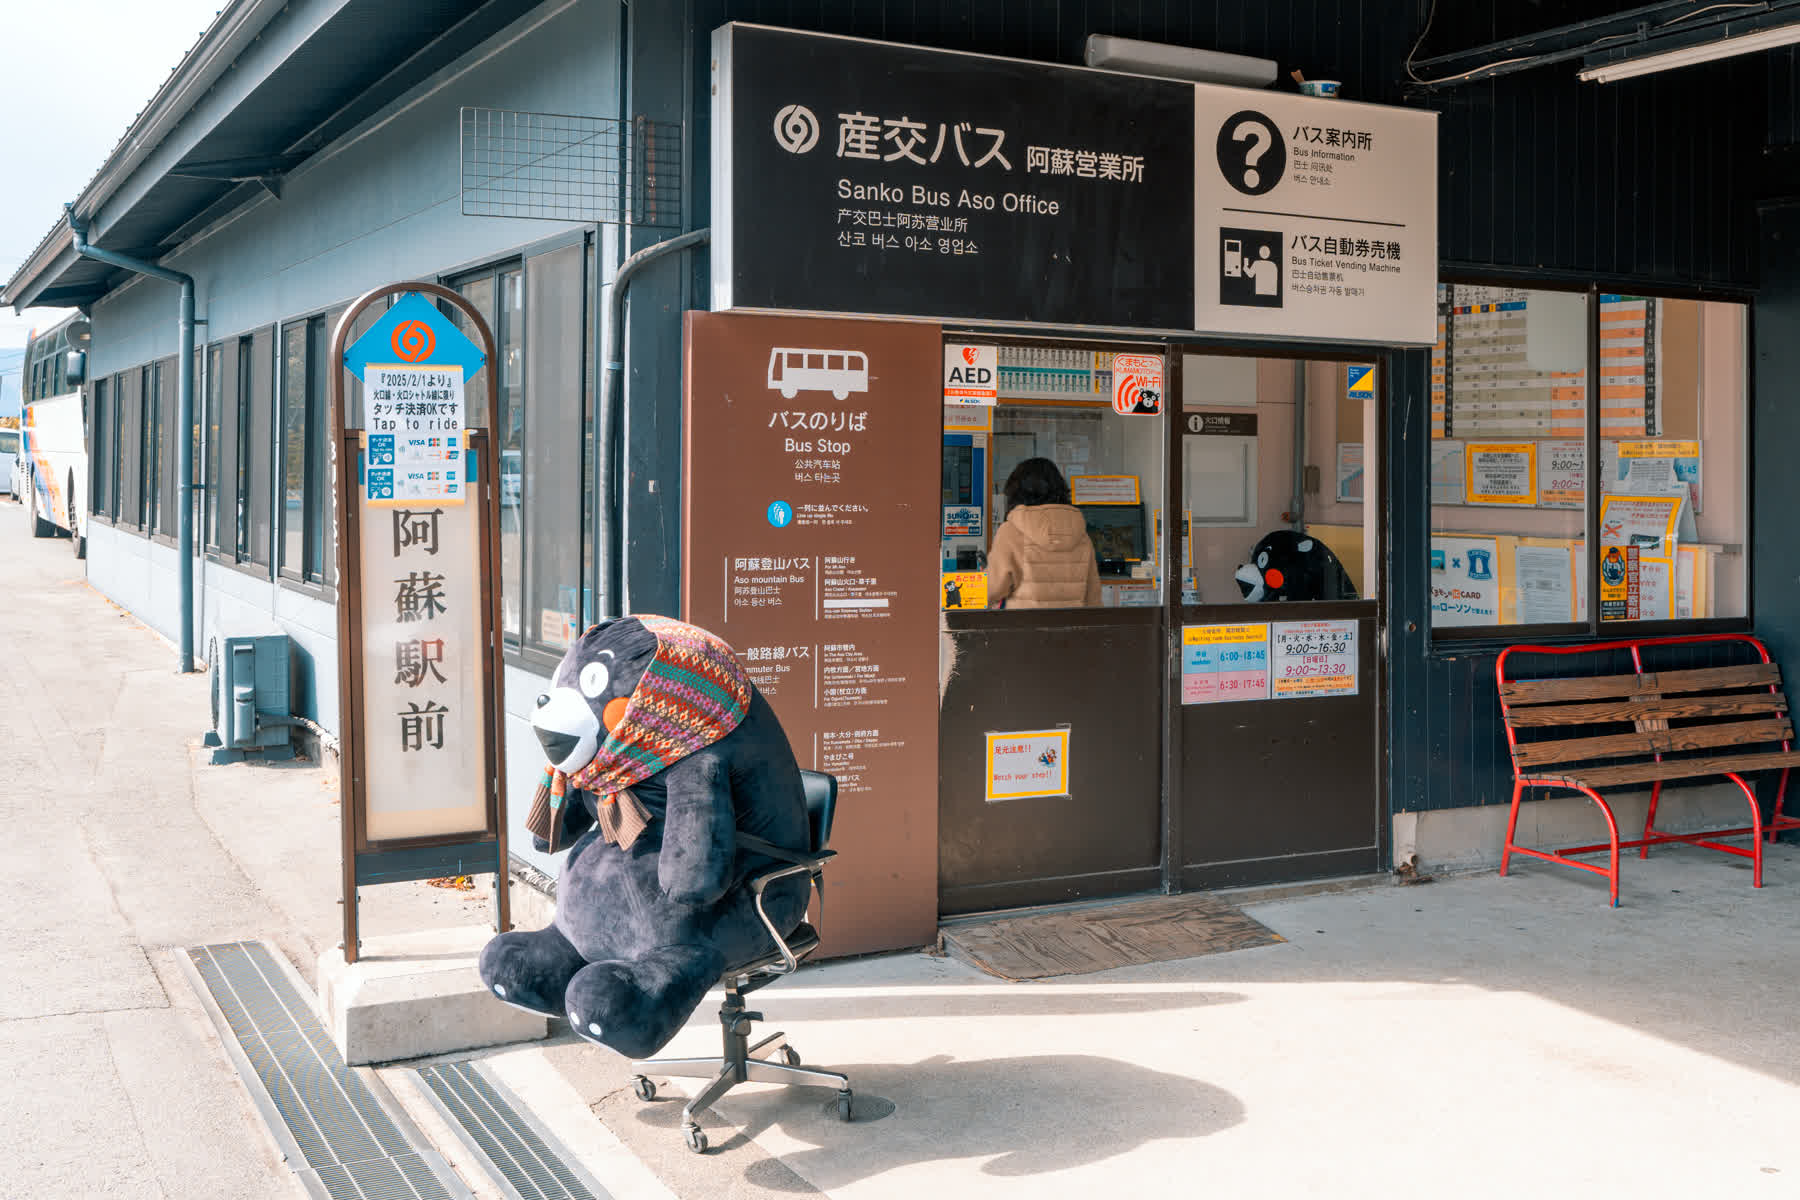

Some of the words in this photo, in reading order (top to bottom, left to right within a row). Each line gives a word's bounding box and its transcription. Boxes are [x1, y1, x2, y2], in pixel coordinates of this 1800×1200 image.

[1293, 126, 1373, 152] バス案内所
[836, 111, 1012, 172] 産交バス
[1026, 145, 1145, 184] 阿蘇営業所
[1293, 147, 1309, 157] Bus
[1311, 149, 1355, 162] Information
[1293, 174, 1308, 184] 버스
[838, 178, 904, 204] Sanko
[911, 184, 951, 209] Bus
[957, 188, 997, 211] Aso
[1002, 192, 1060, 217] Office
[837, 208, 969, 235] 产交巴士阿苏营业所
[837, 230, 867, 249] 산코
[871, 232, 900, 251] 버스
[904, 234, 933, 254] 아소
[937, 236, 979, 257] 영업소
[1291, 235, 1401, 261] バス自動券売機
[1292, 256, 1307, 266] Bus
[1310, 257, 1333, 269] Ticket
[1336, 259, 1367, 273] Vending
[1369, 262, 1401, 274] Machine
[948, 366, 992, 384] AED
[1136, 375, 1161, 388] Wi-Fi
[373, 402, 458, 416] タッチ決済OKです
[373, 417, 397, 432] Tap
[406, 418, 420, 430] to
[429, 417, 458, 430] ride
[768, 411, 868, 432] バスのりば
[784, 438, 813, 453] Bus
[817, 438, 851, 455] Stop
[794, 459, 841, 471] 公共汽车站
[407, 472, 425, 480] VISA
[794, 472, 813, 483] 버스
[814, 472, 841, 484] 타는곳
[734, 557, 810, 571] 阿蘇登山バス
[734, 576, 749, 584] Aso
[751, 575, 788, 584] mountain
[789, 575, 805, 583] Bus
[1461, 591, 1481, 600] CARD
[391, 507, 450, 753] 阿蘇駅前
[735, 646, 810, 661] 一般路線バス
[745, 665, 774, 674] mmuter
[776, 664, 791, 673] Bus
